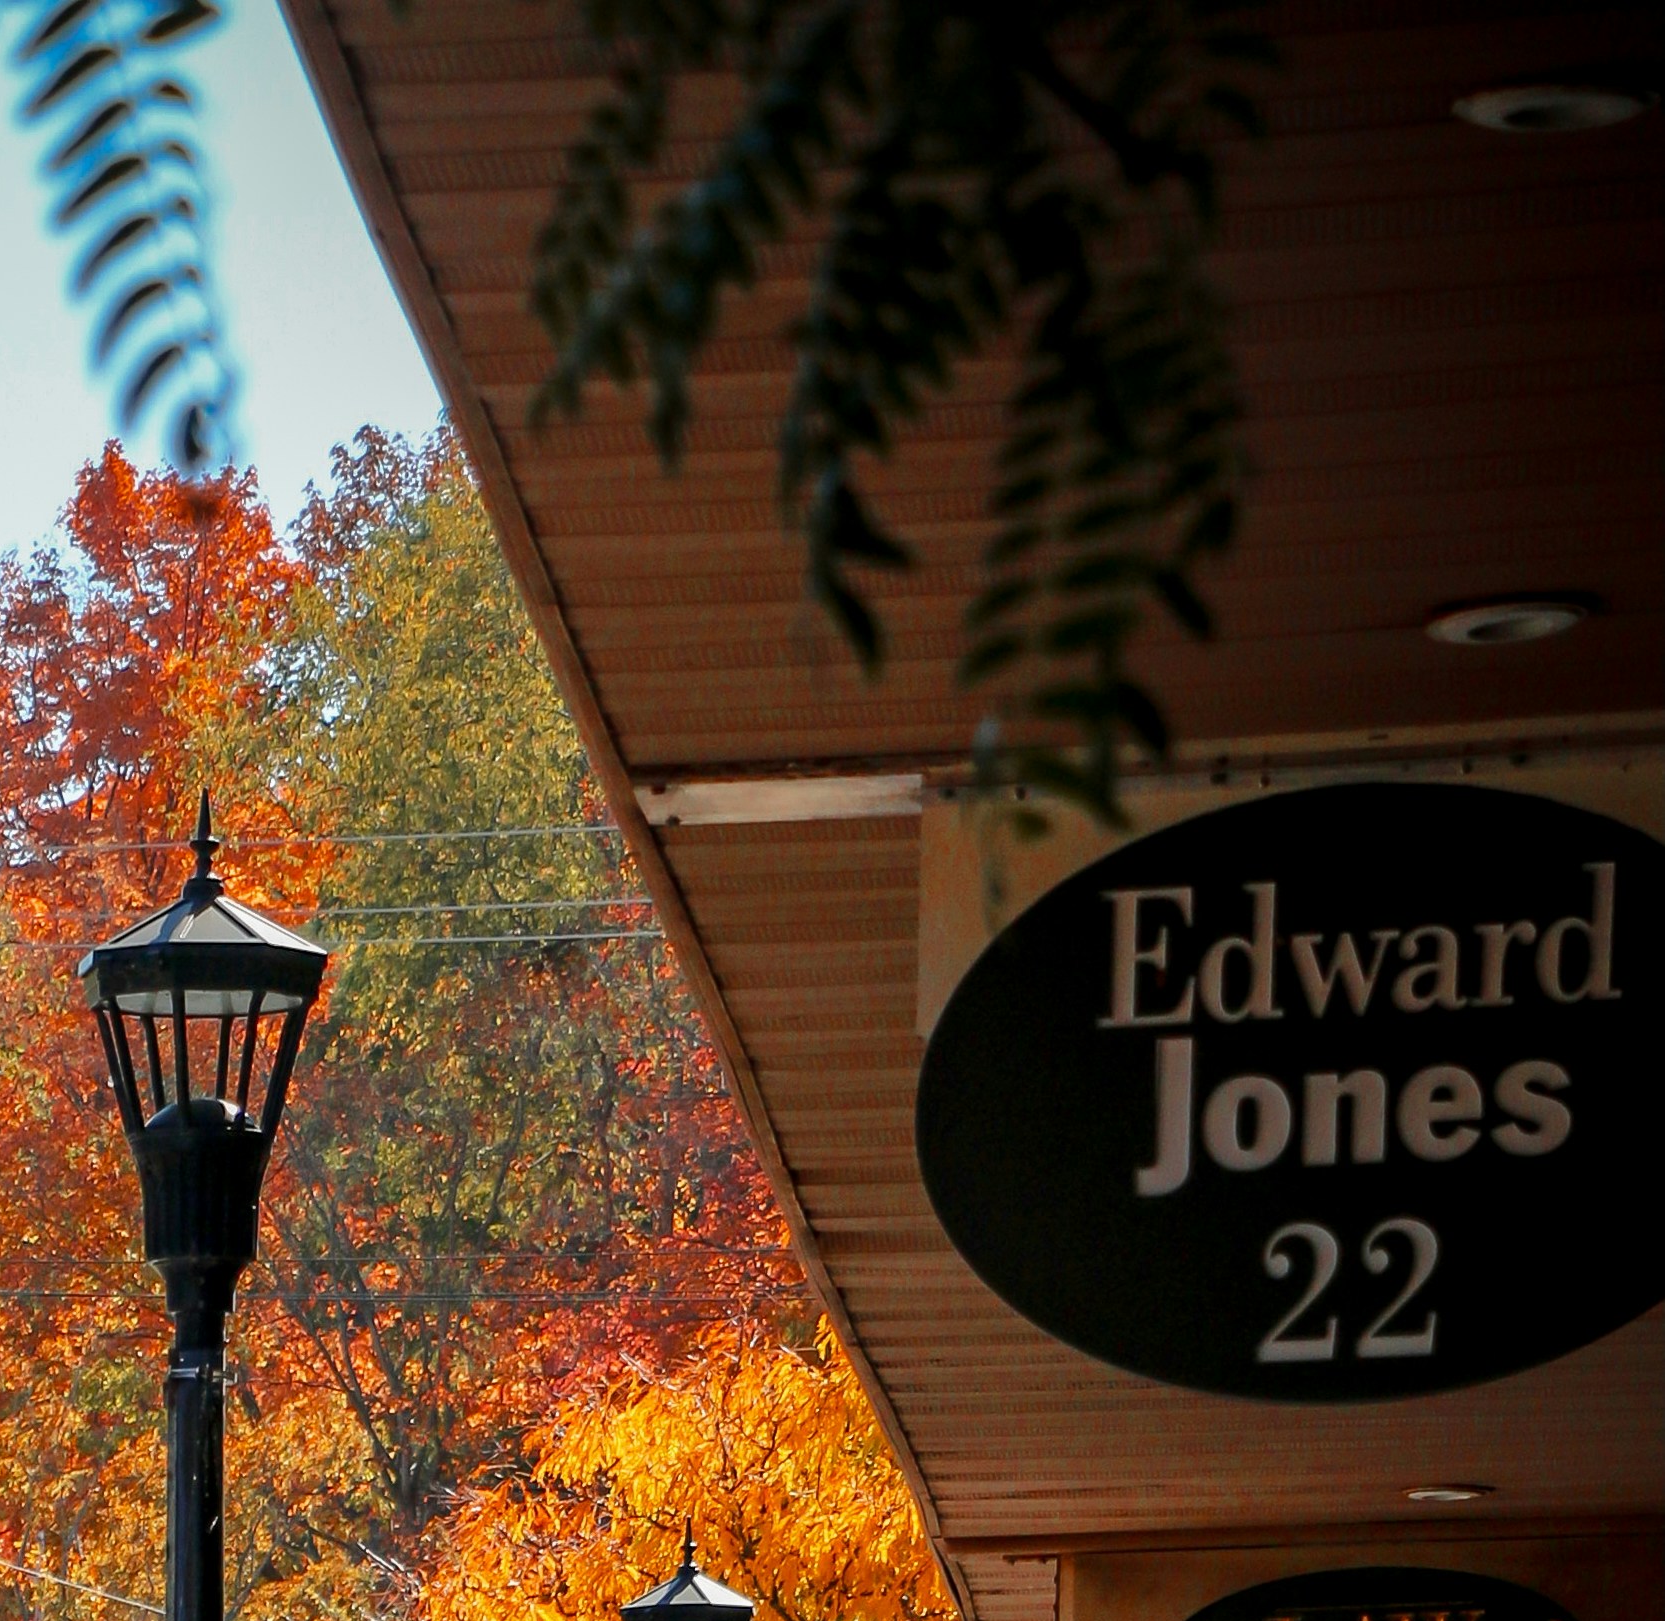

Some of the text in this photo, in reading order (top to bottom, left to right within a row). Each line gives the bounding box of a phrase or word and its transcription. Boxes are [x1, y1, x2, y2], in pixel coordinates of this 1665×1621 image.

[1096, 861, 1622, 1029] Edward
[1136, 1036, 1572, 1196] Jones
[1255, 1216, 1441, 1363] 22
